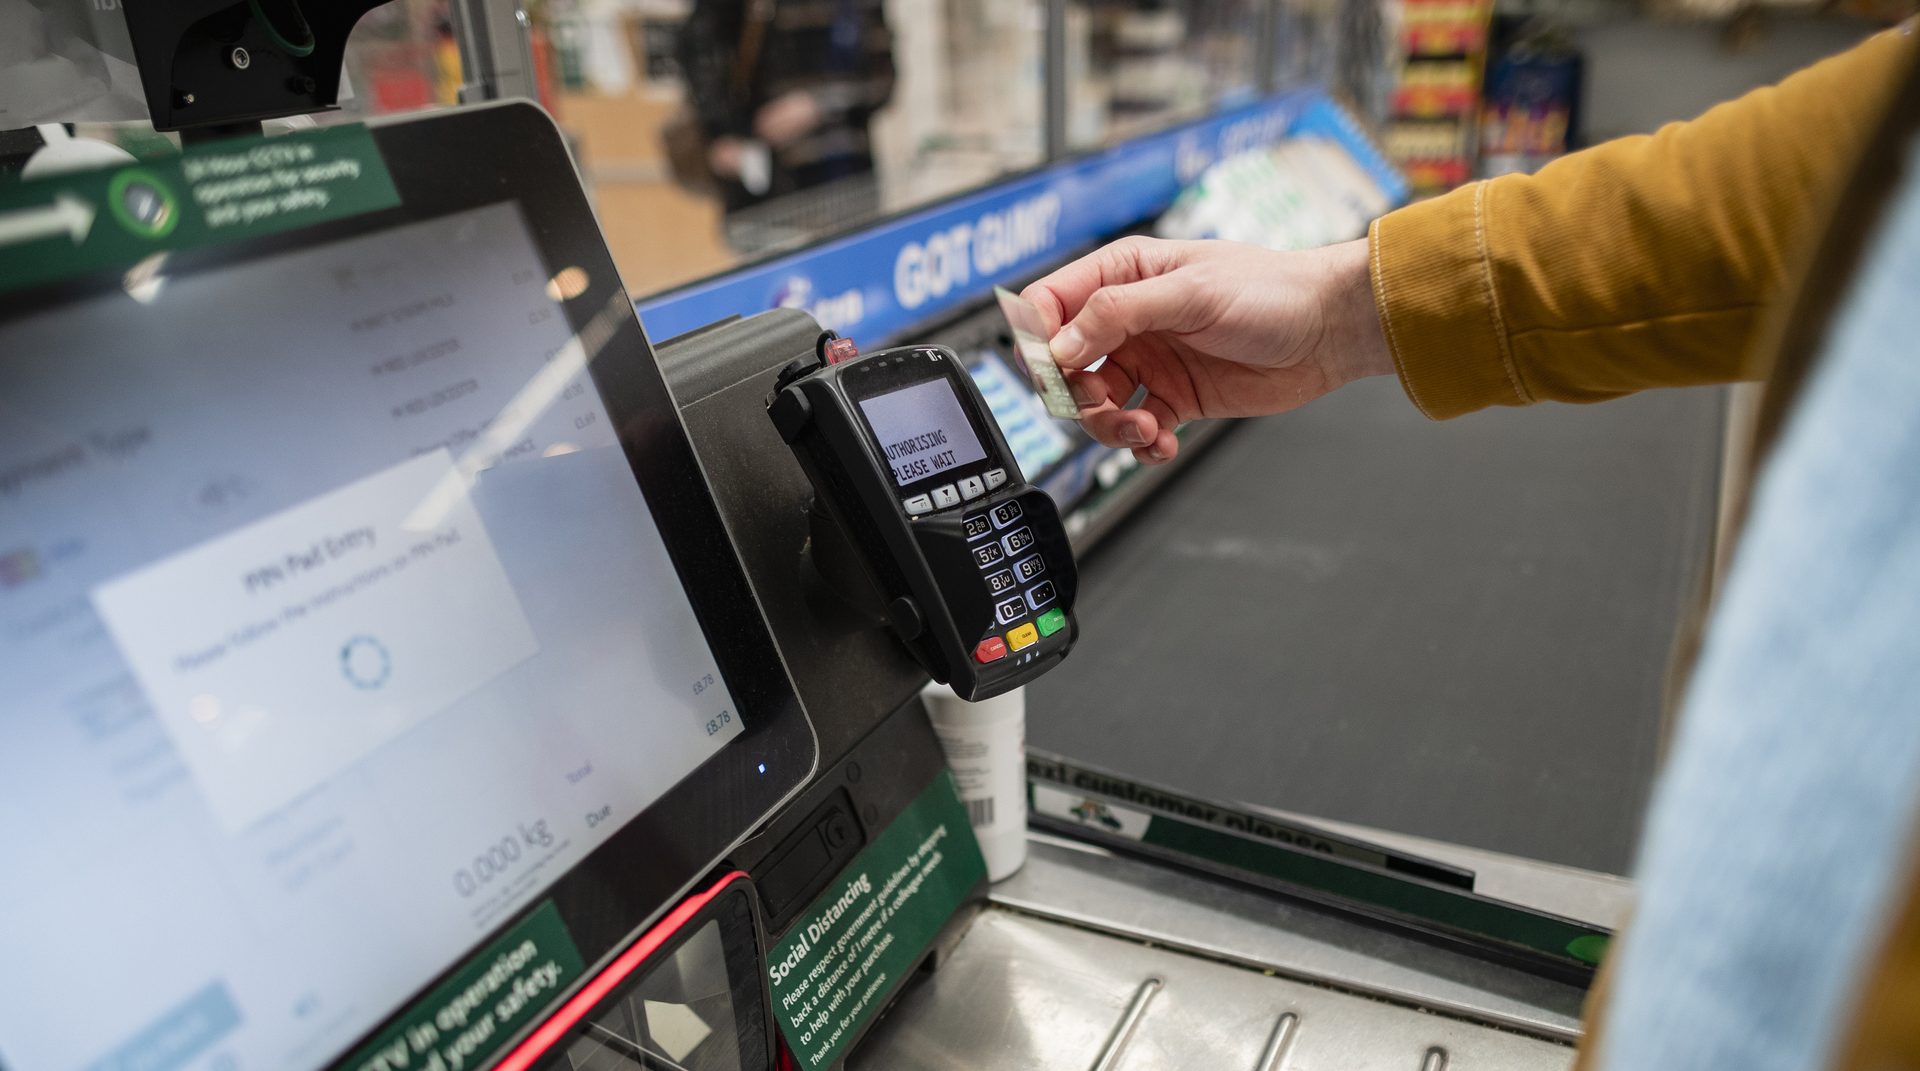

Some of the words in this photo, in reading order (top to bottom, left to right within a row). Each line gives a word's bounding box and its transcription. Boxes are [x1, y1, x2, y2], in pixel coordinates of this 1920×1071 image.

[194, 173, 272, 205] operation
[302, 158, 361, 185] security
[240, 199, 278, 224] your
[893, 223, 974, 310] GOT
[971, 190, 1063, 276] GUM?
[892, 459, 930, 481] PLEASE
[929, 450, 957, 471] WAIT
[920, 501, 927, 509] F1
[945, 496, 952, 504] F2
[998, 508, 1010, 521] 3
[966, 523, 977, 536] 2
[1010, 535, 1021, 548] 6
[285, 544, 326, 574] Pad
[324, 525, 377, 560] Entry
[979, 549, 990, 563] 5
[1022, 562, 1033, 576] 9
[991, 577, 1002, 591] 8
[1003, 604, 1014, 618] 0
[990, 642, 1004, 652] CANCEL
[1021, 631, 1032, 639] CLEAR
[693, 673, 714, 695] £8.78
[706, 710, 731, 736] £8.78
[1026, 759, 1067, 784] ext
[1074, 769, 1217, 822] customer
[584, 804, 613, 829] Due
[453, 834, 522, 898] 0.000
[517, 818, 555, 849] kg
[782, 977, 810, 1010] Please
[807, 945, 838, 983] respect
[836, 898, 878, 954] government
[877, 863, 911, 907] guidelines
[907, 853, 921, 868] by
[917, 823, 948, 858] stepping
[769, 932, 811, 986] Social
[806, 873, 872, 944] Distancing
[790, 1003, 813, 1029] back
[811, 995, 819, 1006] a
[817, 960, 849, 998] distance
[847, 946, 858, 963] of
[860, 920, 883, 949] metre
[887, 907, 895, 917] a
[892, 872, 925, 910] colleague
[921, 850, 944, 877] needs
[405, 1021, 440, 1055] in
[435, 938, 539, 1031] operation
[800, 1031, 812, 1046] to
[809, 1010, 830, 1035] help
[828, 987, 847, 1012] with
[844, 968, 863, 997] your
[860, 931, 895, 976] purchase.
[443, 1011, 496, 1071] your
[494, 958, 564, 1023] safety.
[809, 1040, 832, 1067] Thank
[829, 1027, 843, 1047] you
[839, 1015, 851, 1032] for
[848, 1002, 863, 1022] your
[861, 972, 887, 1006] patience
